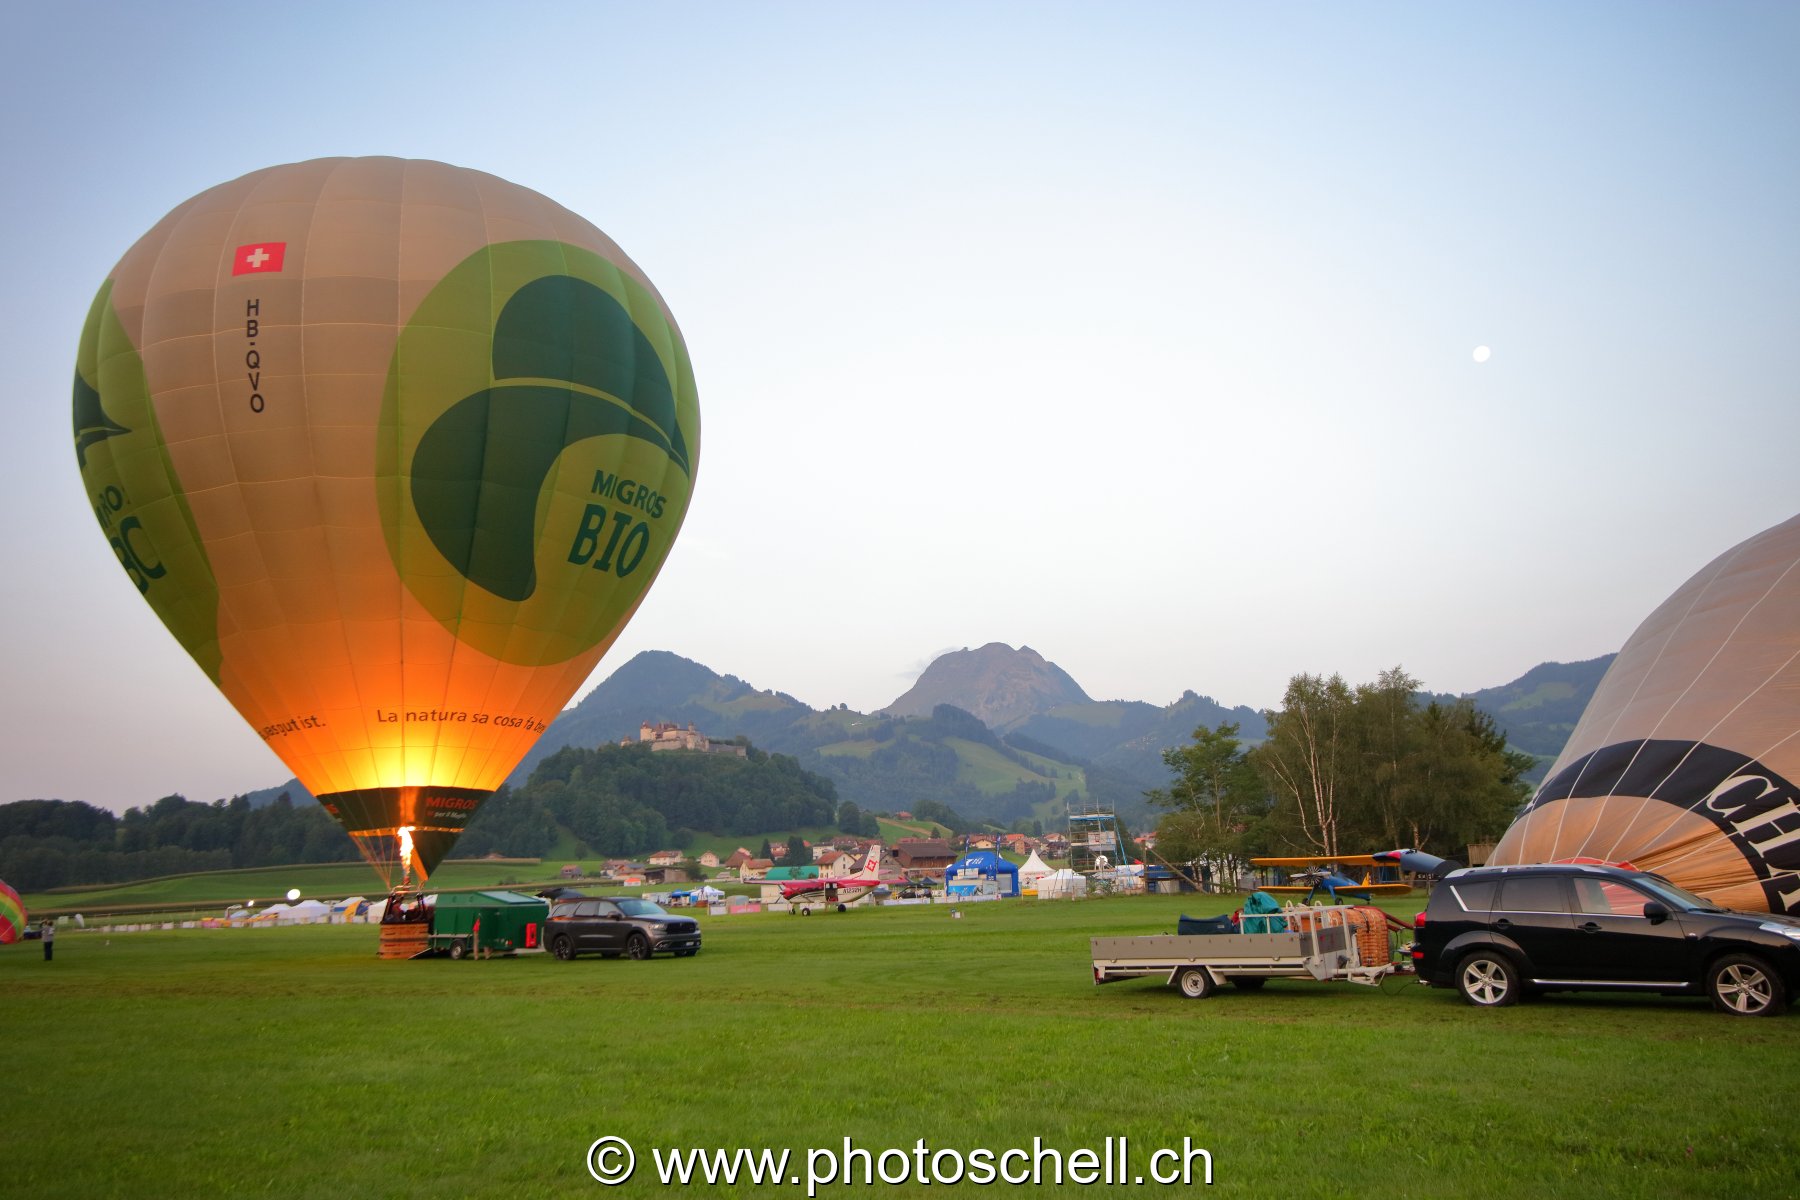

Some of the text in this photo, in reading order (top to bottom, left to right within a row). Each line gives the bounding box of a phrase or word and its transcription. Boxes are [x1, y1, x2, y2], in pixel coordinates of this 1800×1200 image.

[590, 469, 668, 519] MIGROS
[567, 503, 650, 578] BIO
[377, 709, 398, 722] La
[405, 709, 466, 722] natura
[471, 713, 489, 724] sa
[493, 715, 523, 728] cosa
